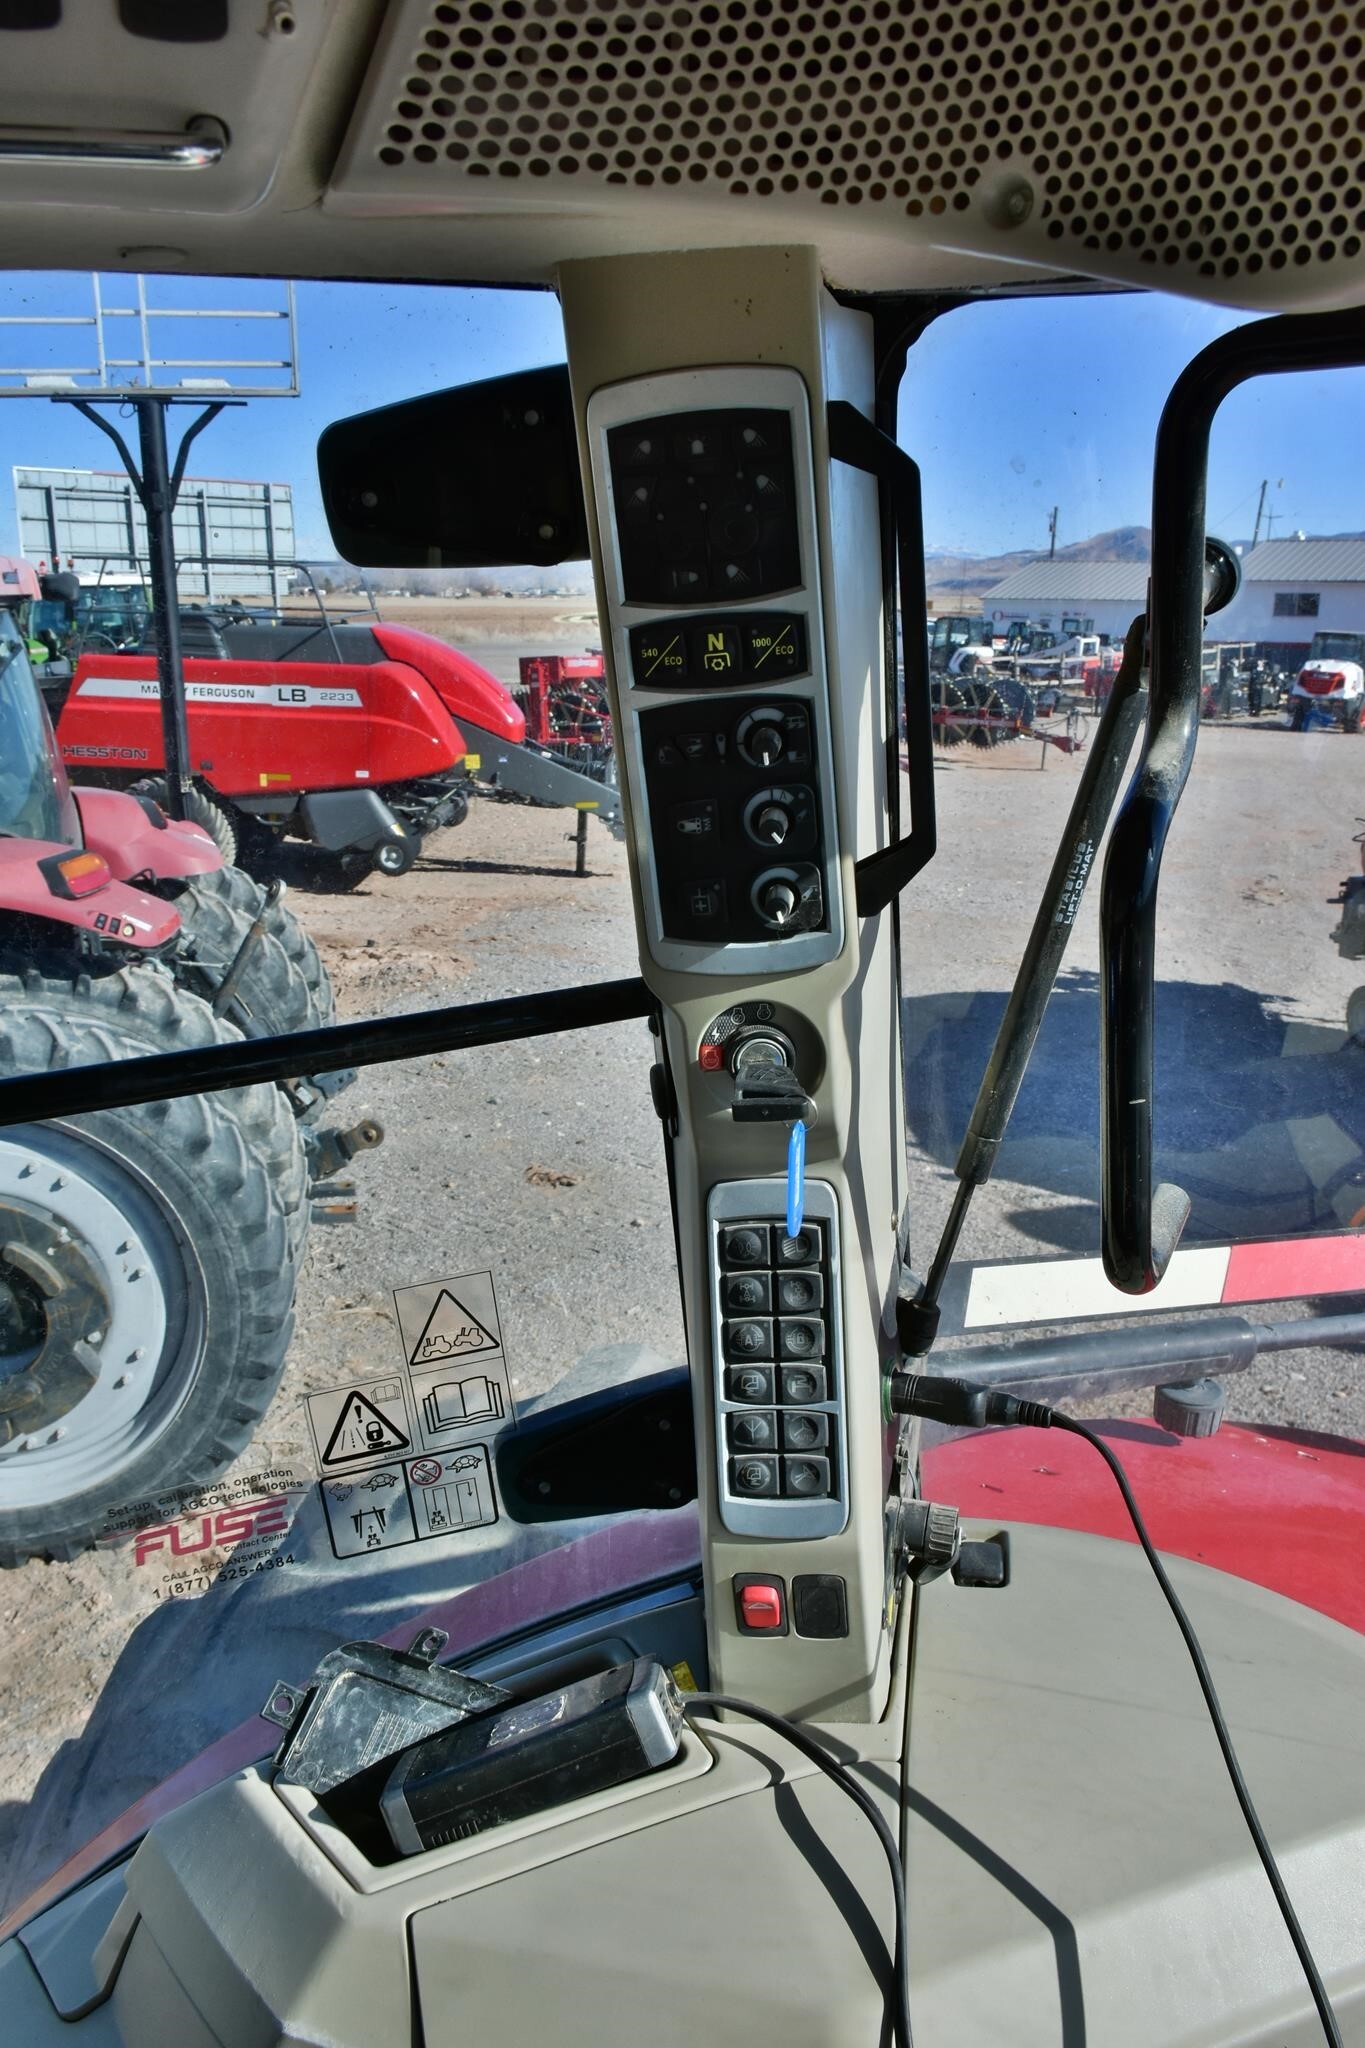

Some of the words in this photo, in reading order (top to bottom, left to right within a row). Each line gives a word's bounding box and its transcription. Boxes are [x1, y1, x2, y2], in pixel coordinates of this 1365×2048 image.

[707, 632, 724, 651] N
[751, 637, 772, 648] 1000
[775, 645, 794, 655] ECO
[641, 648, 658, 659] 540
[664, 656, 683, 666] ECO
[193, 687, 255, 699] FERGUSON
[278, 688, 307, 703] LB
[320, 692, 354, 701] 2233
[63, 746, 147, 760] HESSTON
[1055, 842, 1087, 923] STABILUS
[158, 1482, 231, 1506] calibration,
[233, 1468, 294, 1488] operation
[103, 1515, 155, 1532] support
[157, 1507, 176, 1519] for
[179, 1496, 220, 1512] AGCO
[220, 1480, 304, 1503] technologies
[134, 1497, 289, 1567] FUSE
[224, 1538, 260, 1553] Contact
[261, 1531, 292, 1545] Center
[192, 1561, 224, 1577] AGCO
[225, 1547, 279, 1567] ANSWERS
[152, 1588, 161, 1600] 1
[168, 1575, 212, 1598] (877)
[219, 1553, 296, 1583] 525-4384
